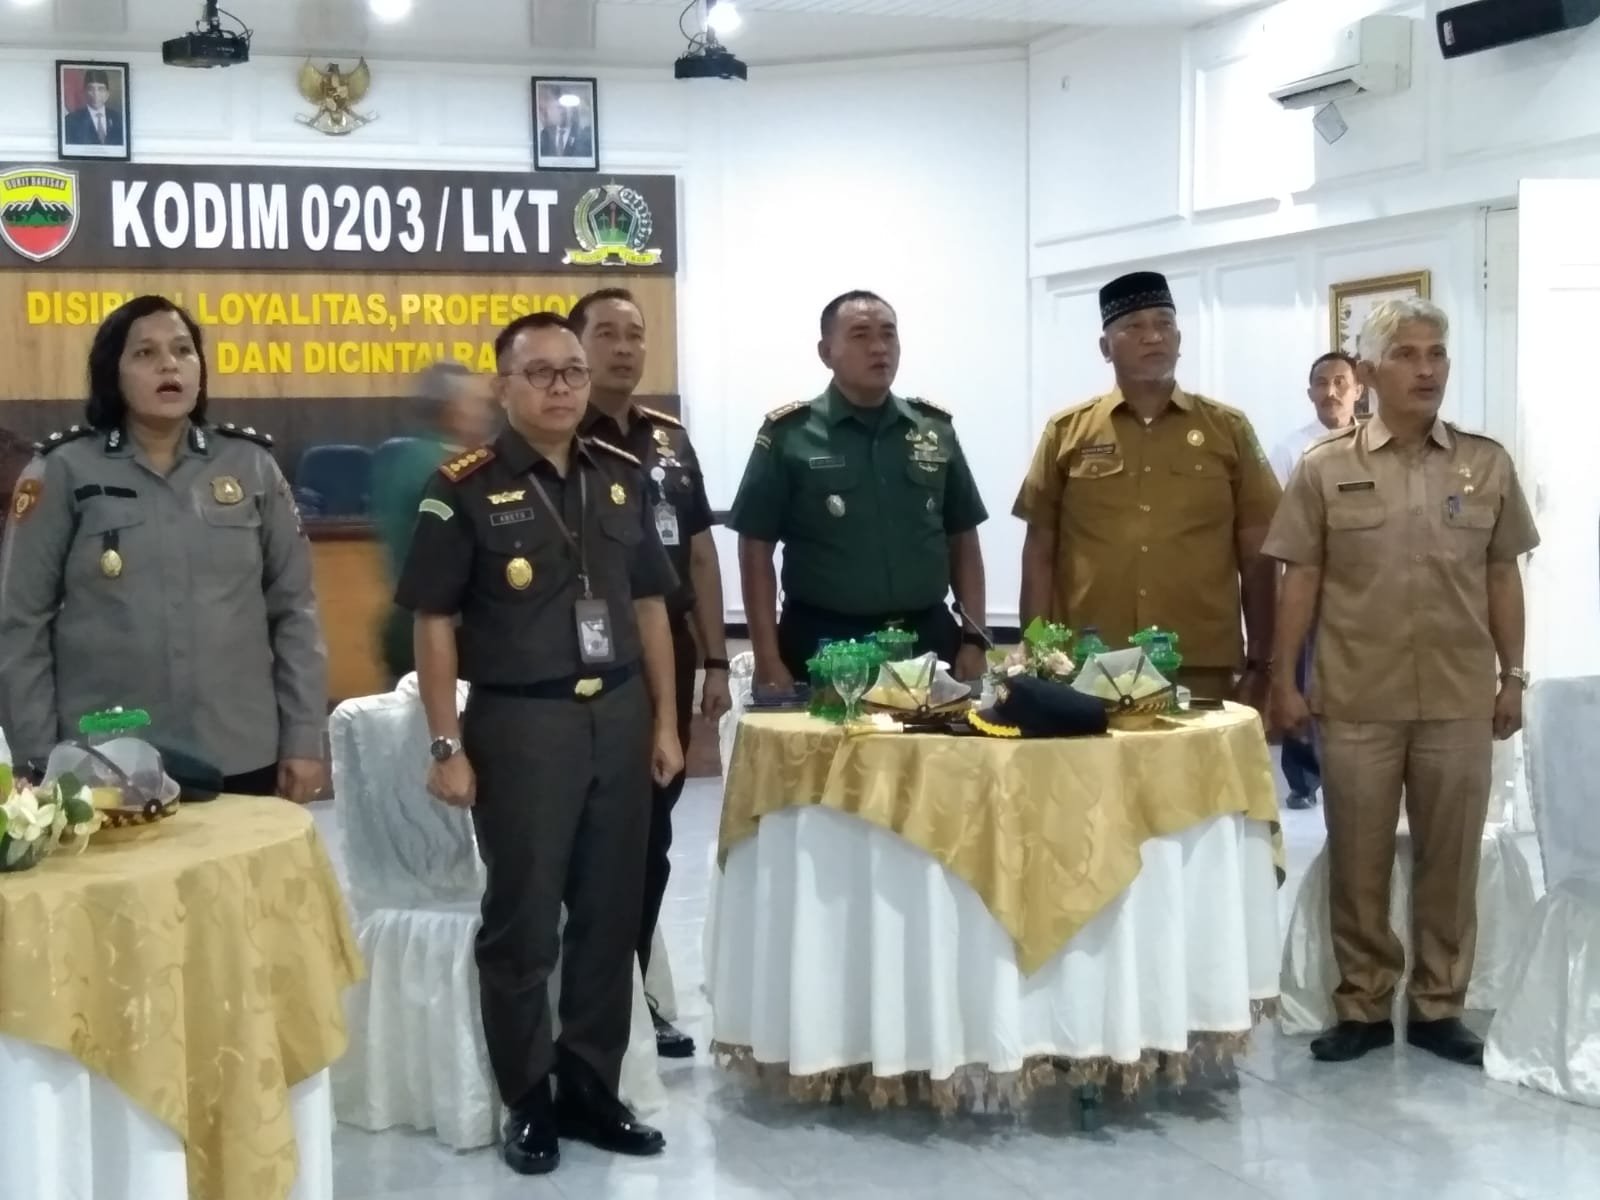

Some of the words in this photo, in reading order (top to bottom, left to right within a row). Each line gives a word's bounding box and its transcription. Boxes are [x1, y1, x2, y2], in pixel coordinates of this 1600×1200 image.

[111, 181, 288, 250] KODIM
[302, 184, 425, 253] 0203
[462, 187, 558, 253] LKT
[27, 291, 183, 324] DISIP
[401, 294, 579, 326] PROFESIO
[217, 342, 291, 373] DAN
